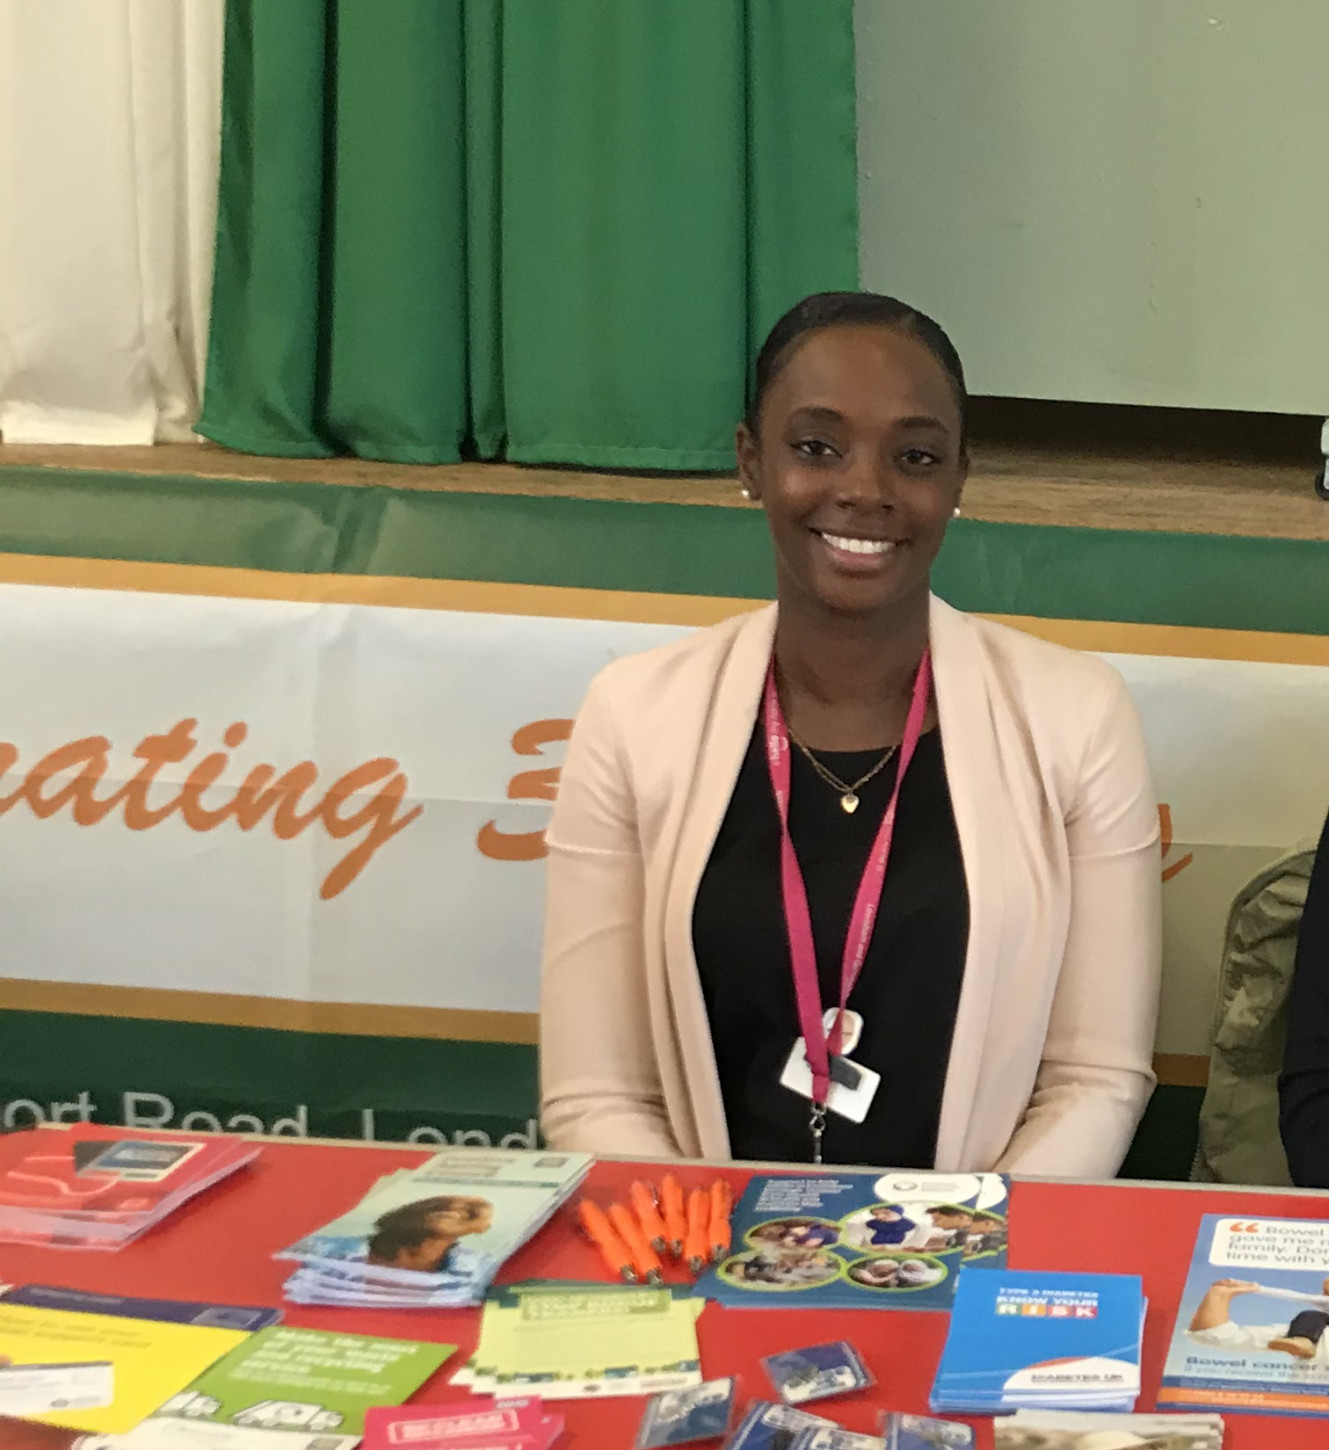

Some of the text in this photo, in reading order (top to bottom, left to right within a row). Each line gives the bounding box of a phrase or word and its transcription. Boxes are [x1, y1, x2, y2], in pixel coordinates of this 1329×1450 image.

[0, 717, 425, 901] ating
[1265, 1226, 1324, 1238] Bowel
[1229, 1234, 1276, 1245] gave
[1282, 1237, 1316, 1245] me
[1226, 1251, 1269, 1262] time
[1274, 1254, 1316, 1264] with
[1185, 1356, 1246, 1368] Bowel
[1252, 1360, 1318, 1372] cancer
